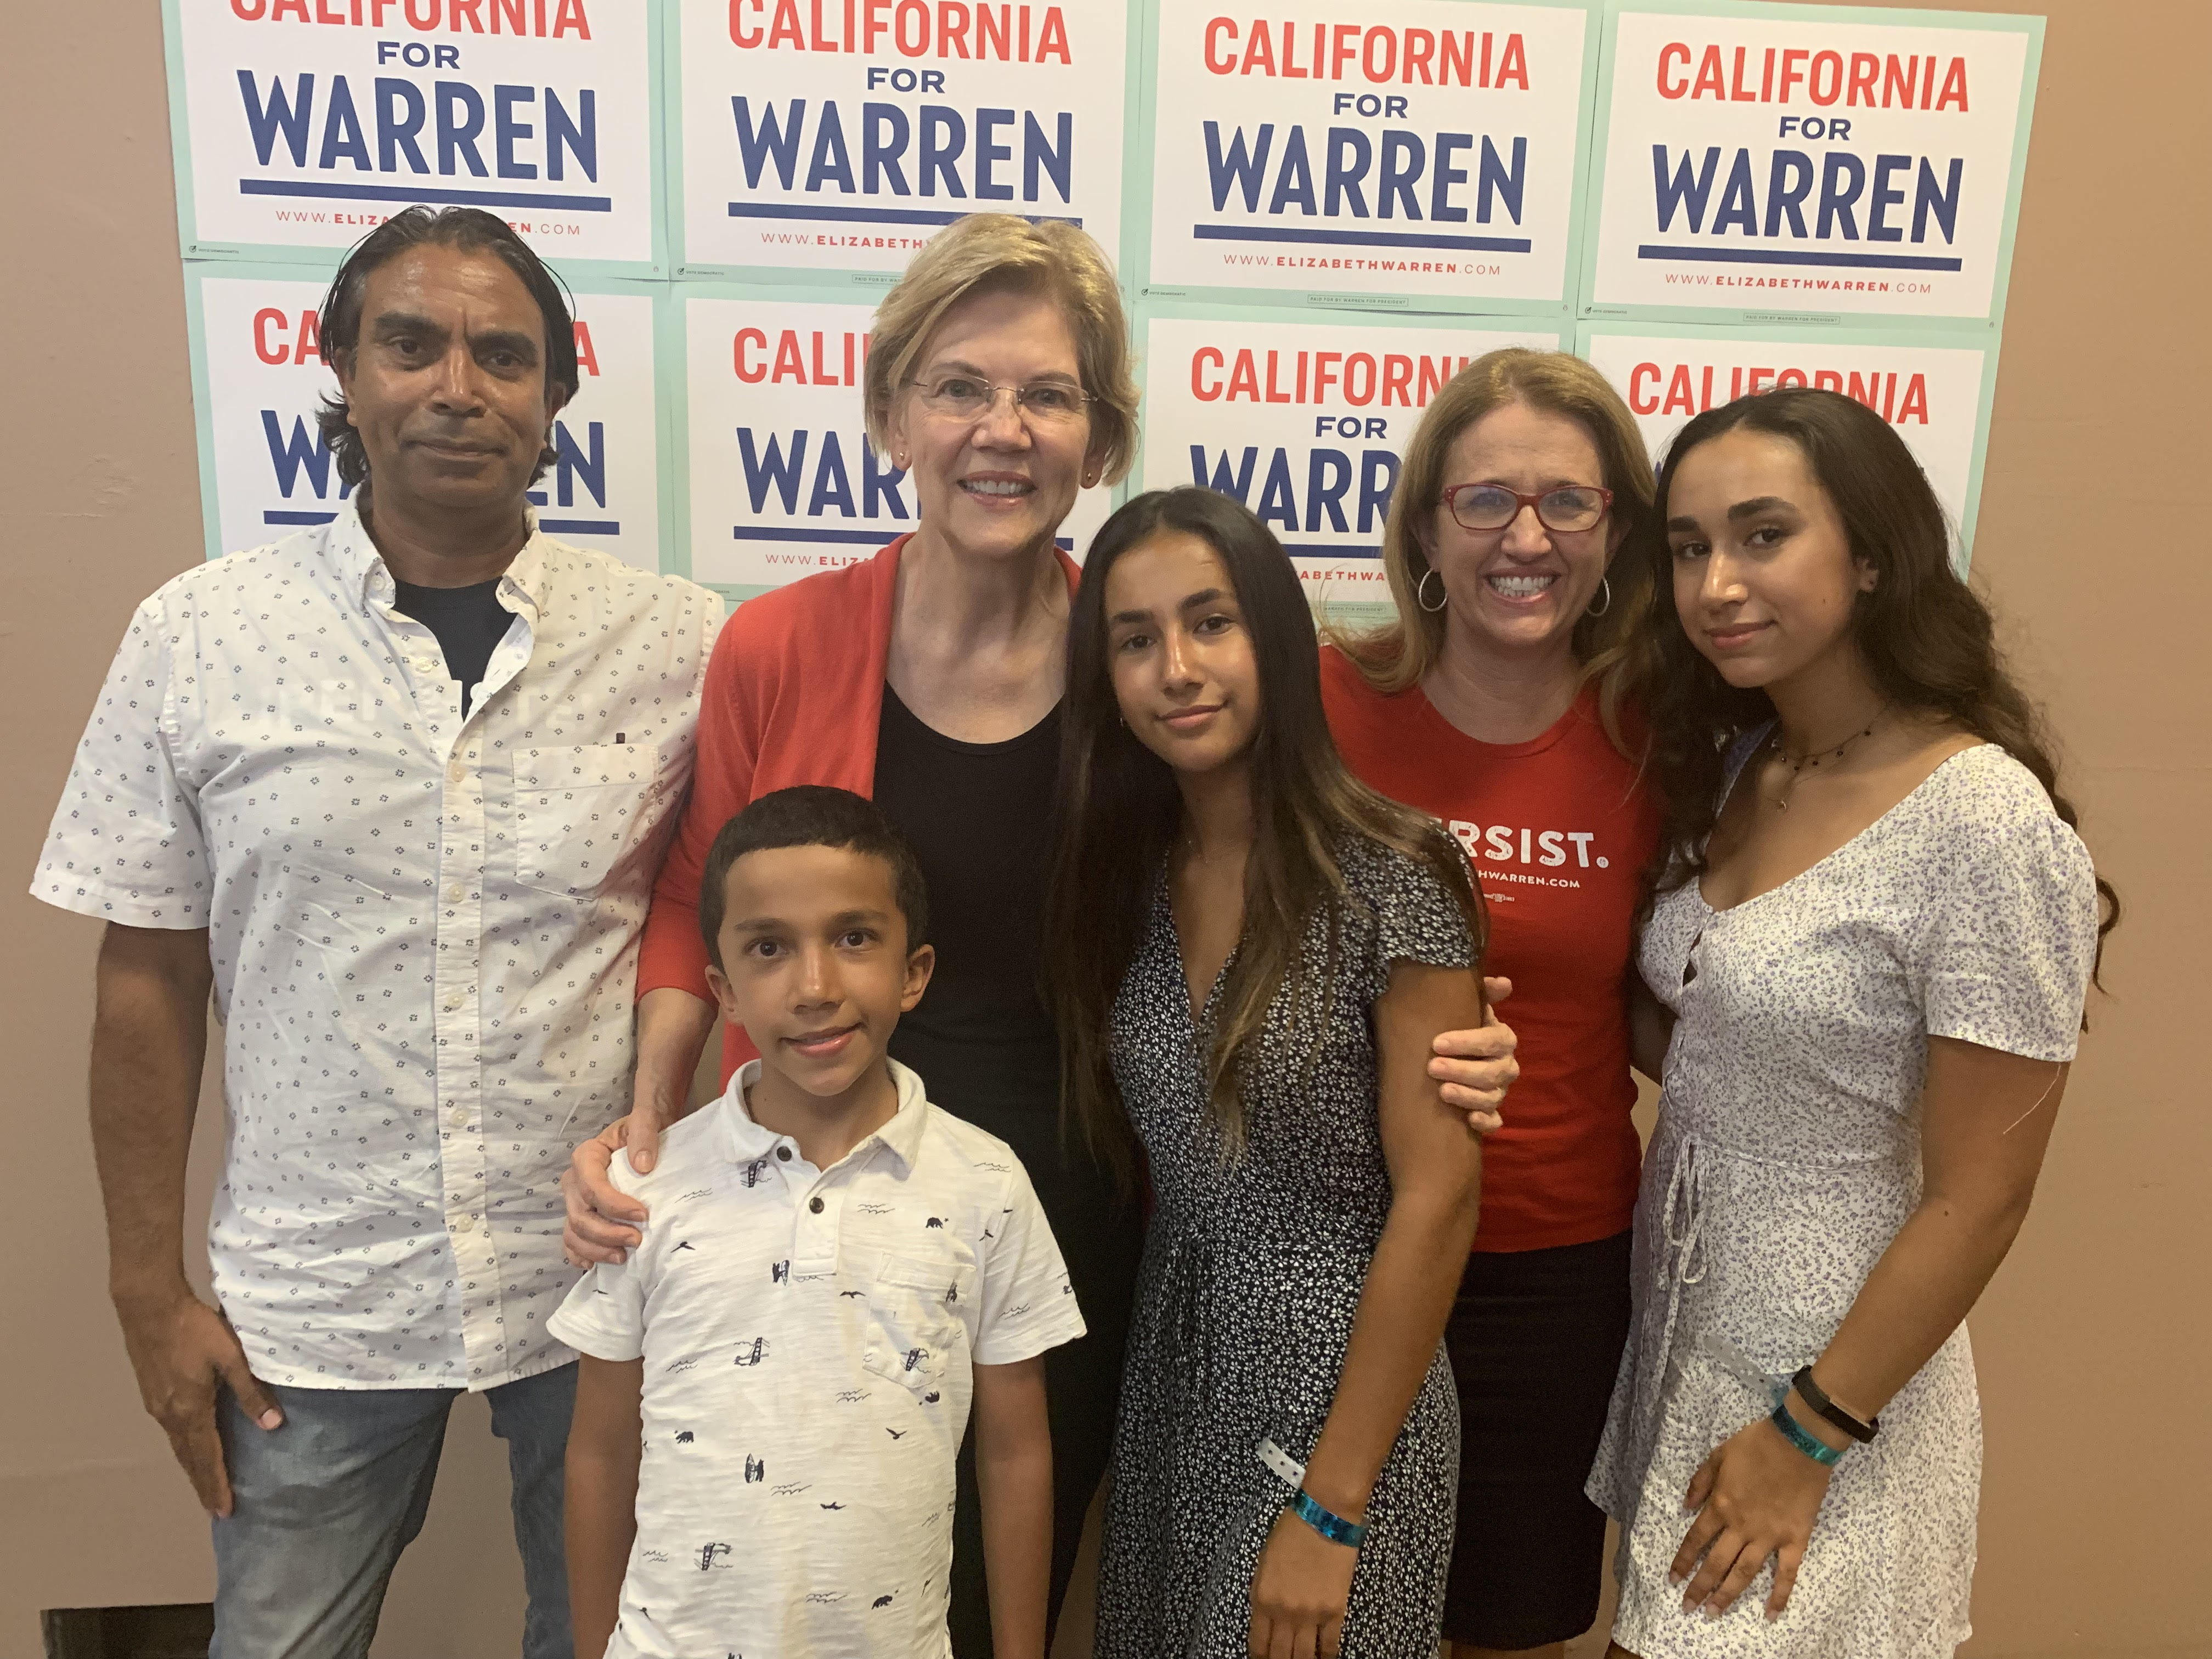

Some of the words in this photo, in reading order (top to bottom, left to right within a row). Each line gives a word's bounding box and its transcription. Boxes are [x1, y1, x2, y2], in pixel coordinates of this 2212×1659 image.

[377, 41, 460, 70] FOR
[729, 0, 1071, 65] CALIFORNIA
[1205, 16, 1530, 91] CALIFORNIA
[867, 67, 945, 94] FOR
[1334, 93, 1408, 119] FOR
[1657, 42, 1968, 112] CALIFORNIA
[236, 70, 598, 183] WARREN
[731, 96, 1072, 204] WARREN
[1779, 116, 1852, 140] FOR
[1203, 120, 1528, 225] WARREN
[1652, 144, 1963, 245] WARREN
[1224, 254, 1500, 275] WWW.ELIZABETHWARREN.COM
[1665, 273, 1932, 294] WWW.ELIZABETHWARREN.COM
[1191, 346, 1469, 408] CALIFORN
[1316, 416, 1387, 439] FOR
[736, 427, 922, 520] WAR
[1190, 445, 1403, 533] WARR
[1430, 817, 1609, 868] RSIST.
